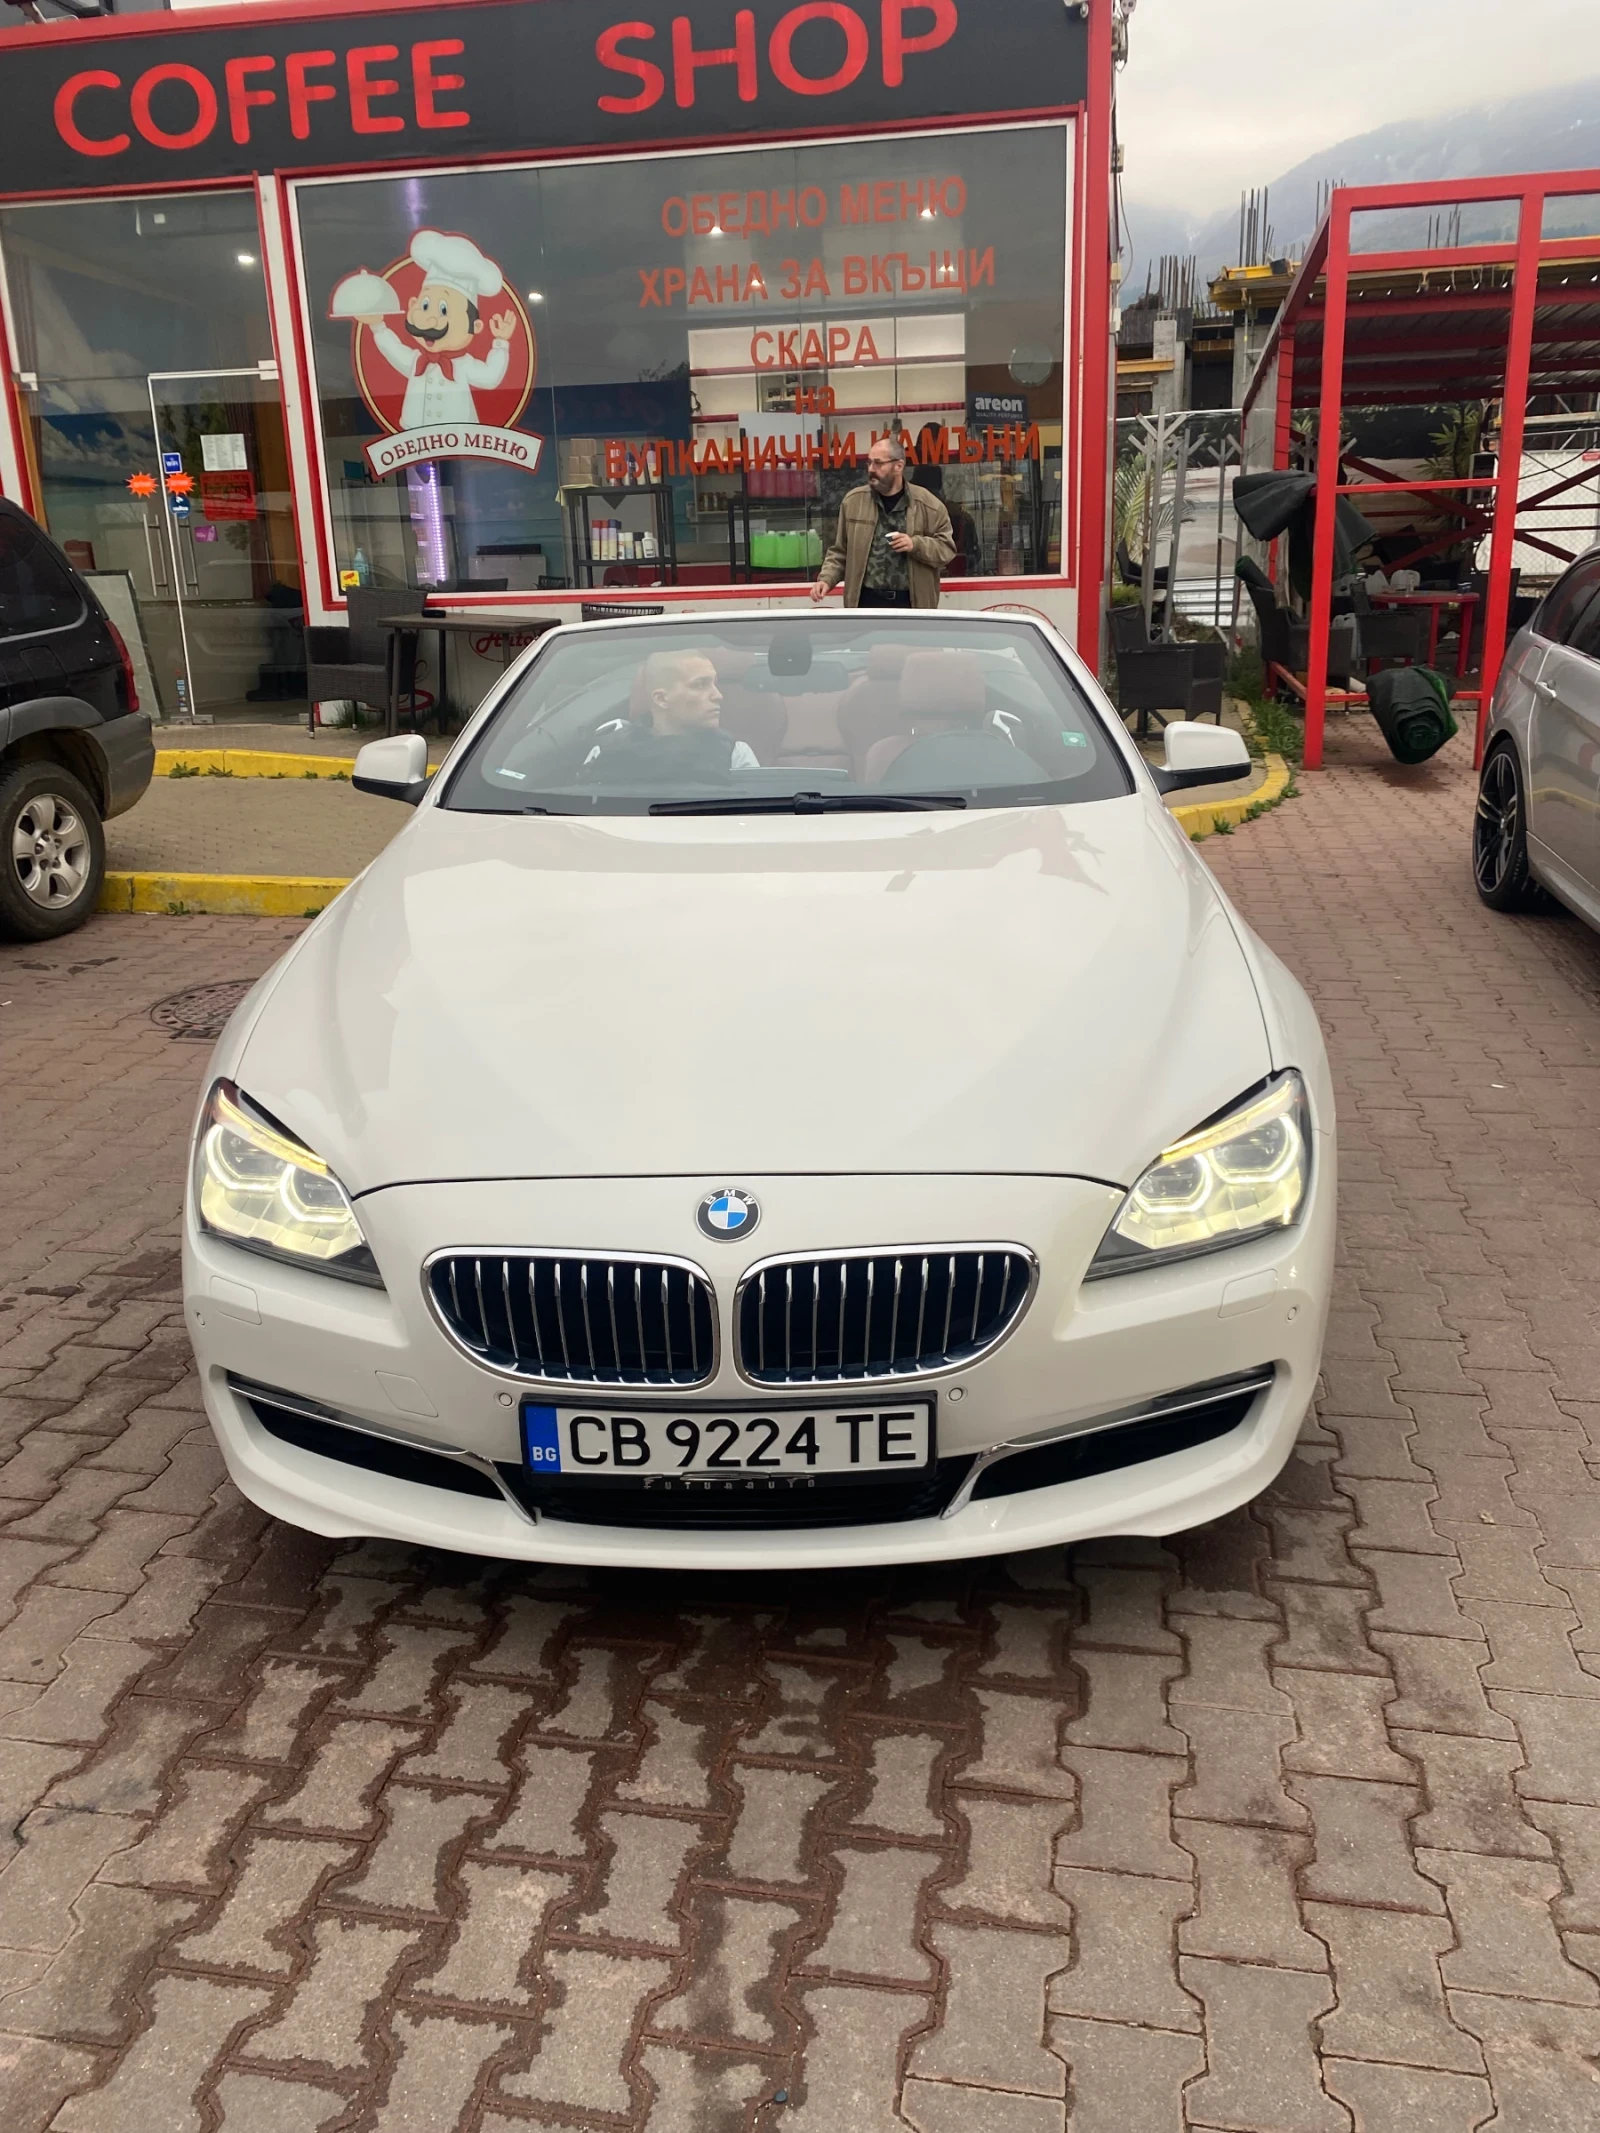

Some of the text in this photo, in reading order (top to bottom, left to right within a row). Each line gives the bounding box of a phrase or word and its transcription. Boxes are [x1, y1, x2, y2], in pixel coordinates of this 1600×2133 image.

[54, 0, 958, 156] COFFEE SHOP
[661, 175, 968, 240] ОБЕДНО МЕНЮ
[638, 246, 995, 308] ХРАНА ЗА ВКЪЩИ
[750, 325, 880, 369] СКАРА
[795, 386, 836, 415] на
[975, 397, 1023, 412] areon
[380, 433, 528, 466] ОБЕДНО МЕНЮ
[603, 431, 857, 479] ВУЛКАНИЧНИ
[704, 1189, 756, 1205] BMW
[532, 1446, 557, 1462] BG
[569, 1412, 916, 1467] CB 9224 TE
